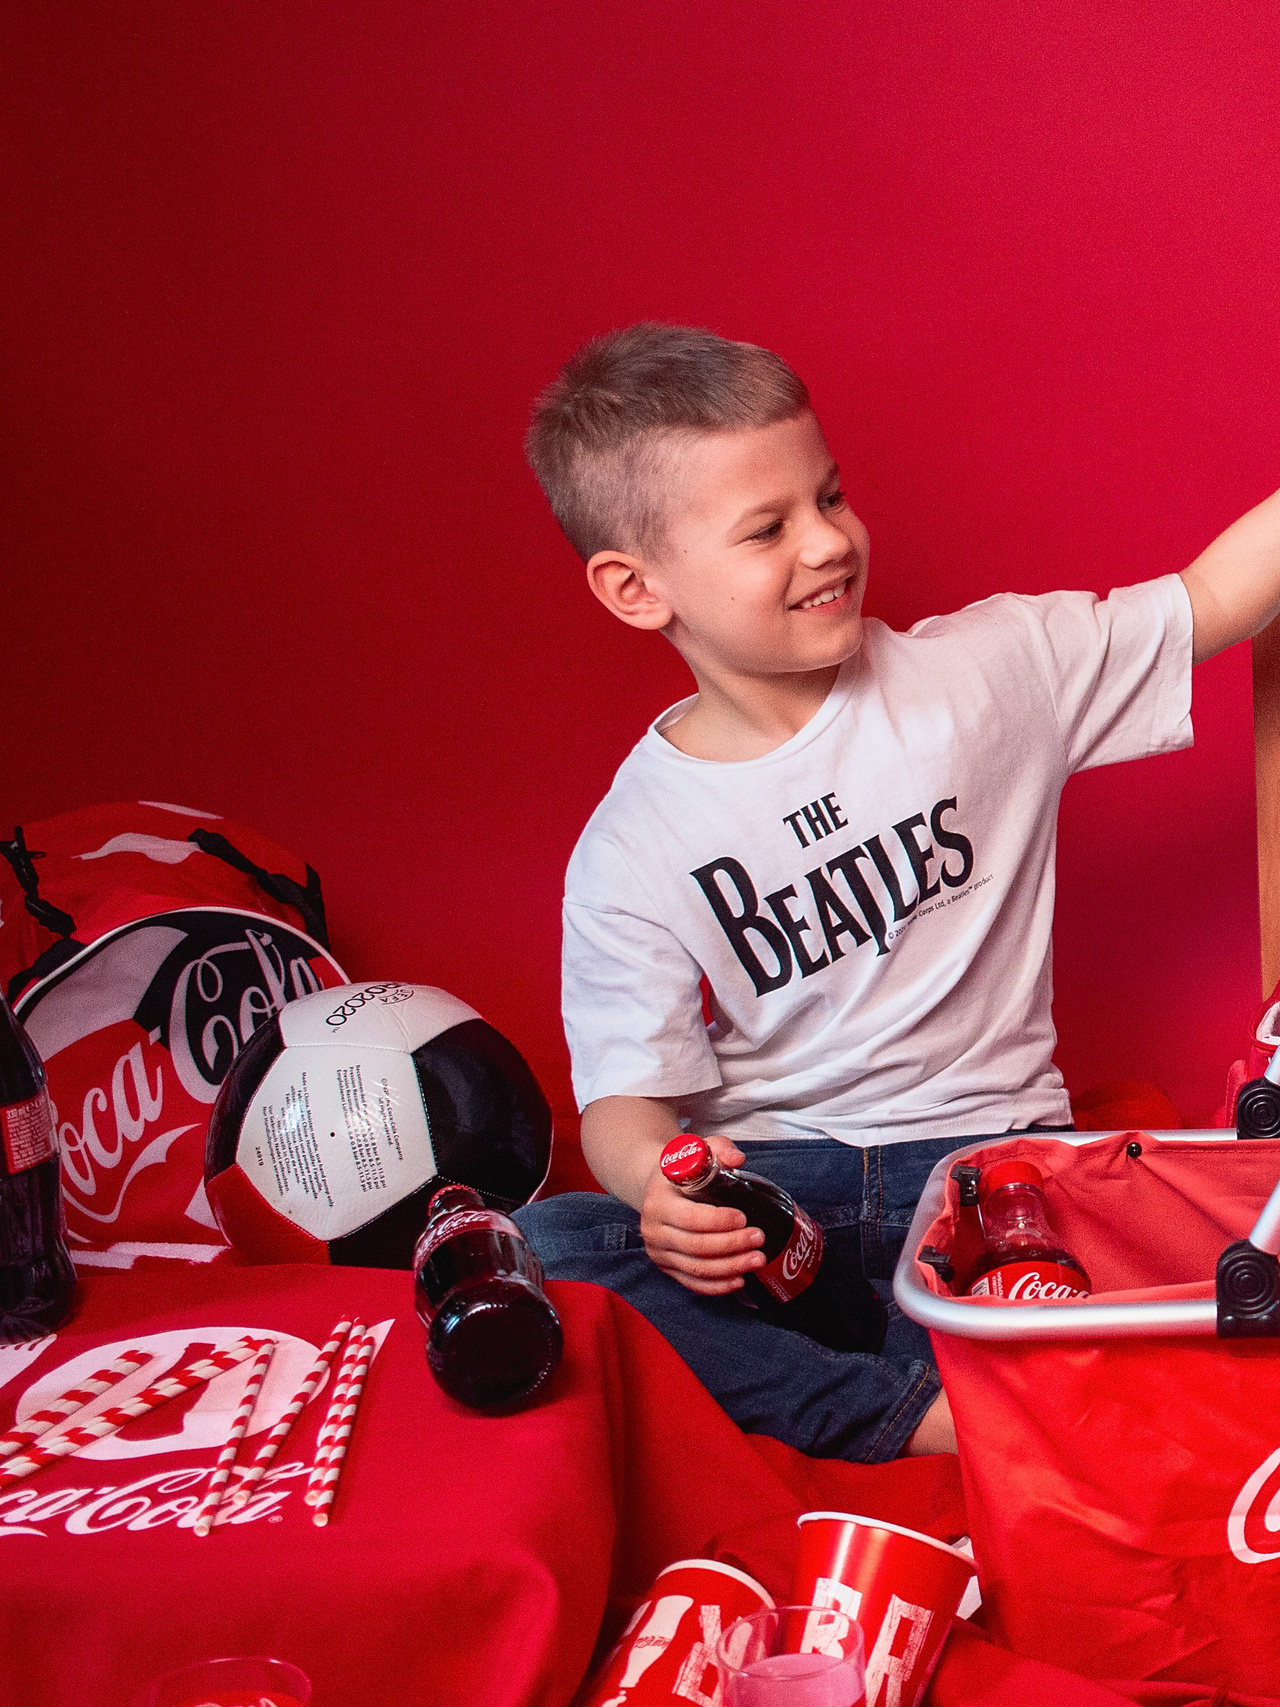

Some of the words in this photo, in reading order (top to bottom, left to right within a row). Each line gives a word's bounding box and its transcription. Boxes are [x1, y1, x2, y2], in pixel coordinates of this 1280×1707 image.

[783, 792, 849, 849] THE
[973, 873, 994, 890] product
[689, 796, 974, 998] BEATLES
[387, 1107, 397, 1133] Coca-Cola
[302, 1154, 310, 1173] pompe
[662, 1142, 699, 1167] Coca-Cola
